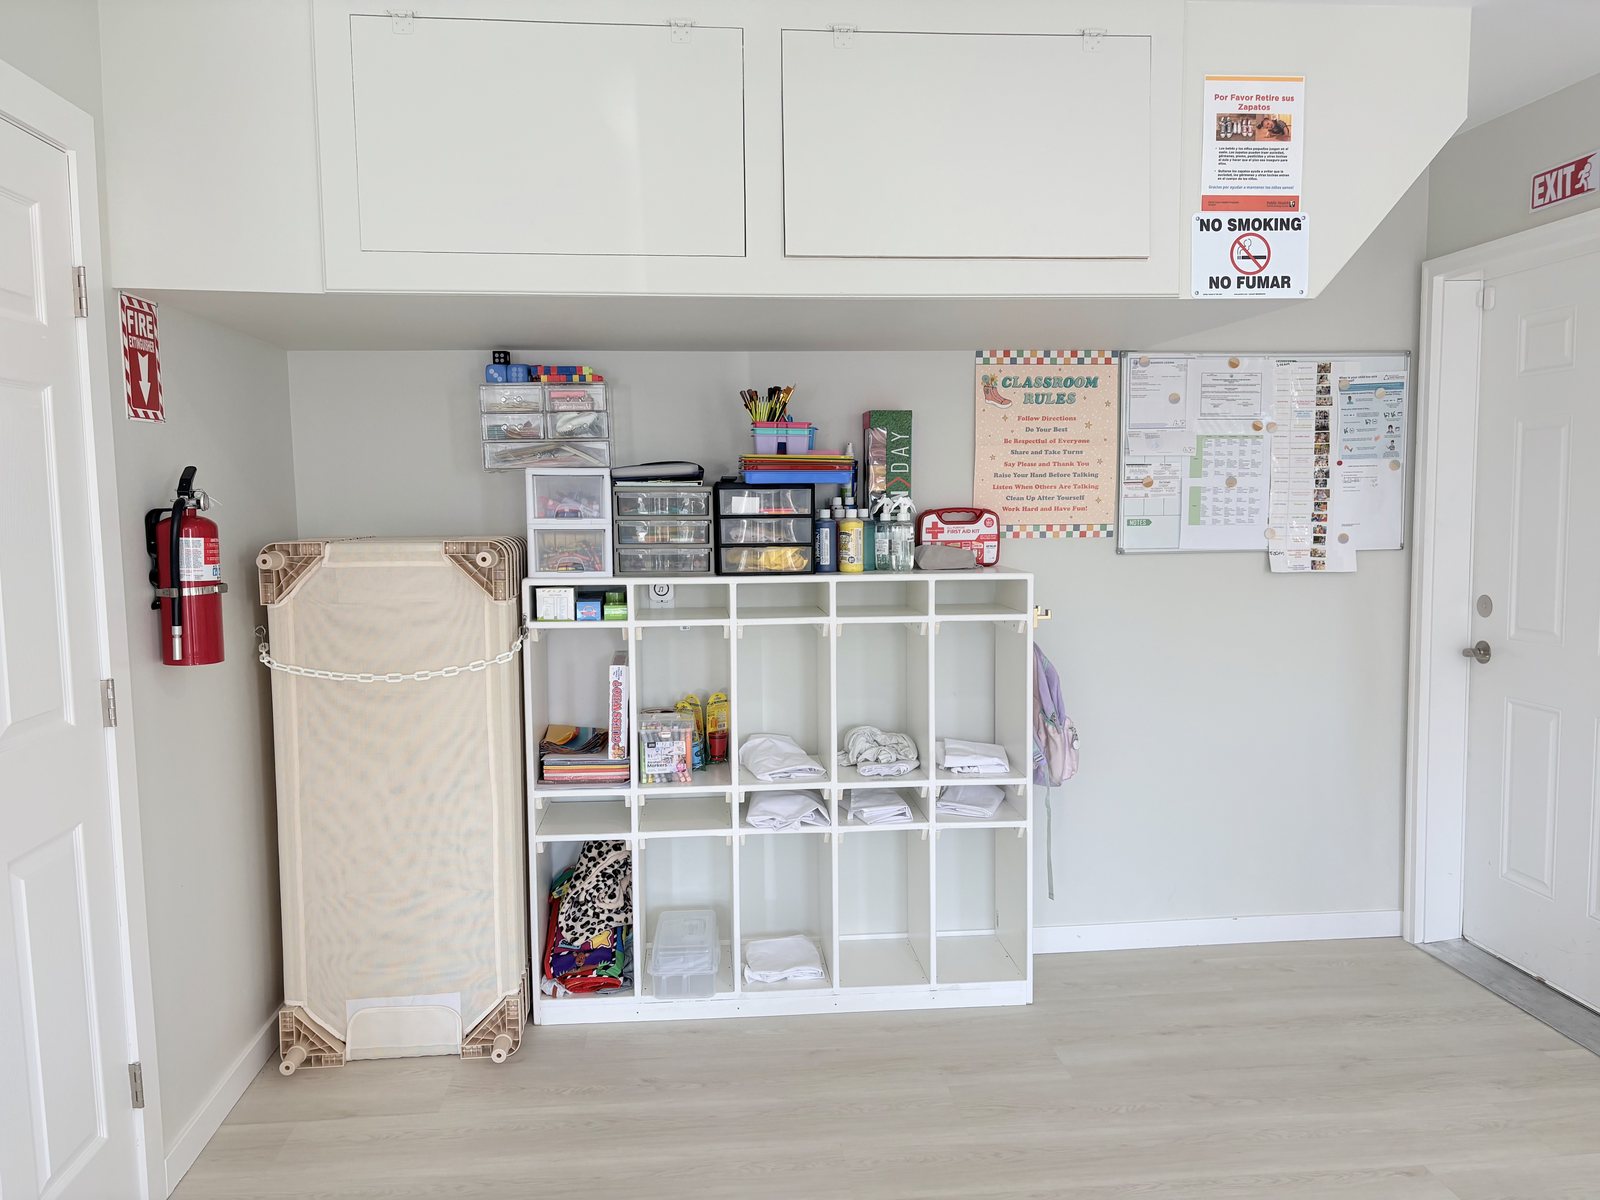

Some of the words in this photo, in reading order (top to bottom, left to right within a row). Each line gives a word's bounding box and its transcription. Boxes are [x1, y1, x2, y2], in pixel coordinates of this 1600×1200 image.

[1533, 164, 1576, 208] EXIT
[1200, 218, 1222, 231] NO
[1227, 218, 1302, 231] SMOKING
[1209, 276, 1231, 289] NO
[1237, 276, 1291, 289] FUMAR
[127, 308, 154, 339] FIRE
[1001, 376, 1099, 388] CLASSROOM
[1023, 392, 1076, 405] RULES
[891, 432, 909, 472] DAY
[612, 680, 623, 711] WHO?
[611, 711, 622, 744] GUESS
